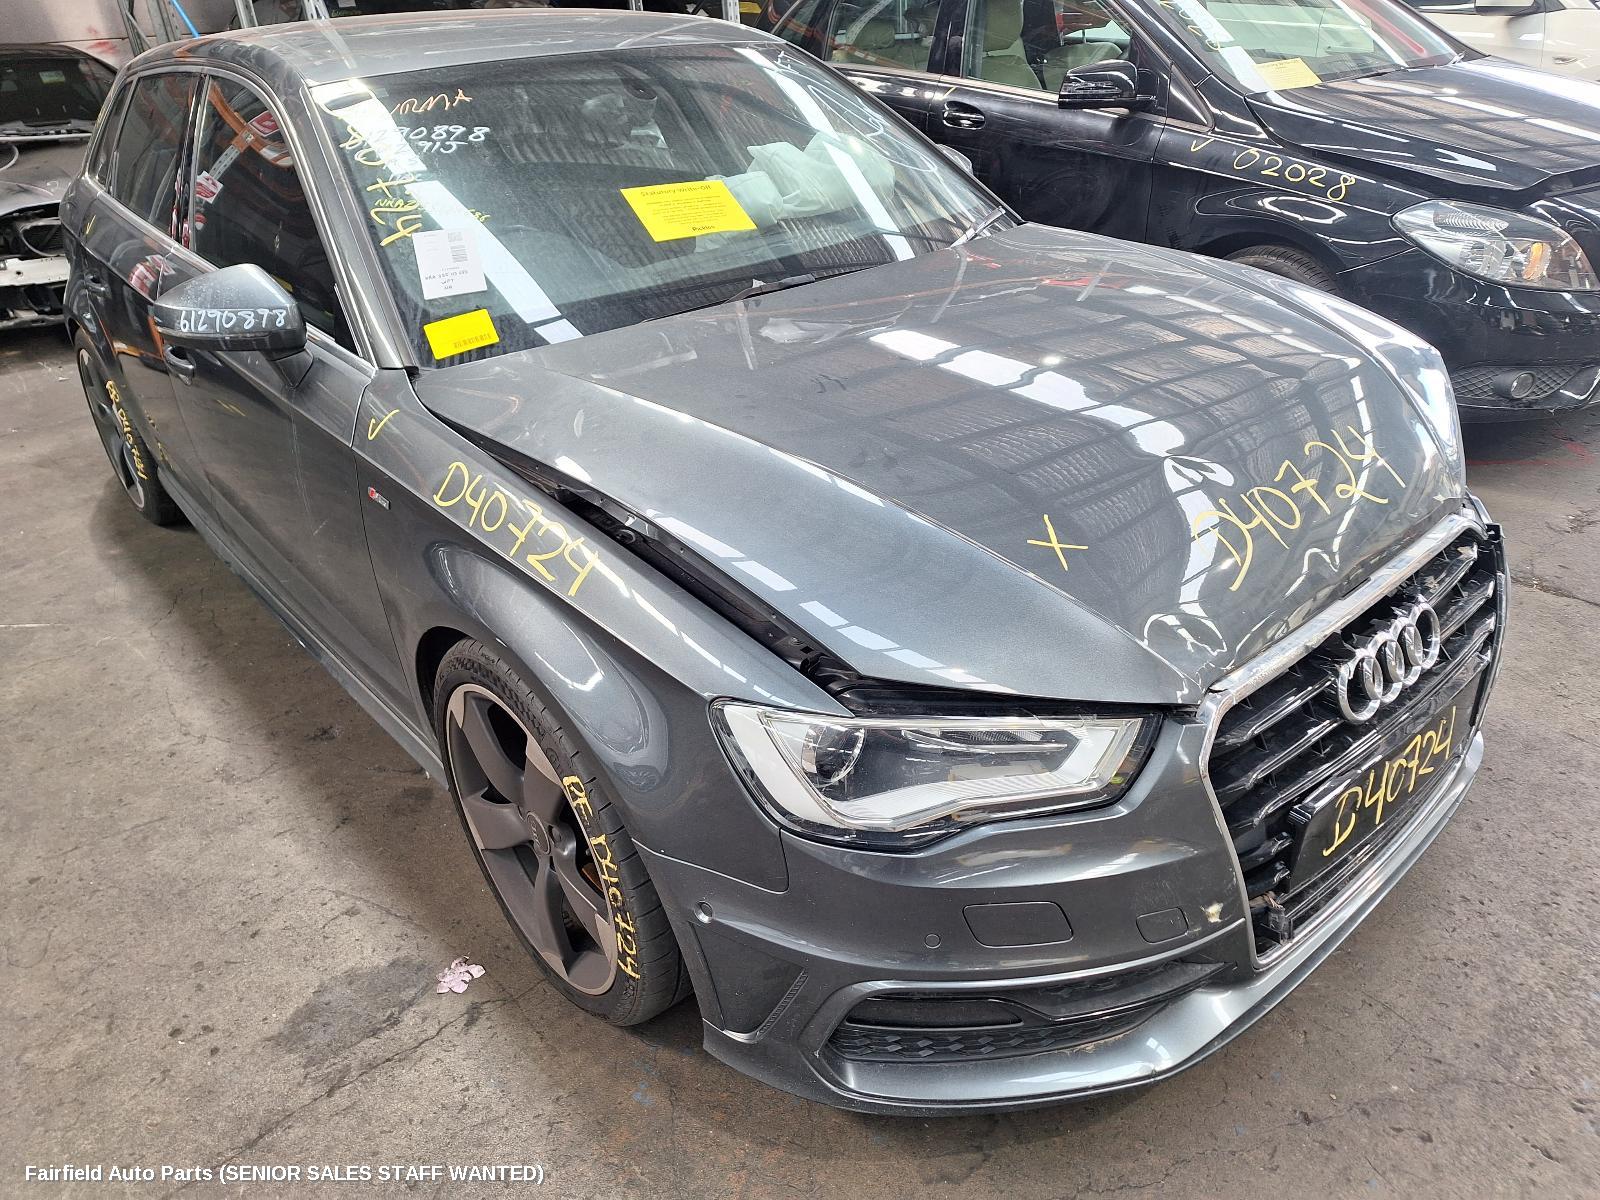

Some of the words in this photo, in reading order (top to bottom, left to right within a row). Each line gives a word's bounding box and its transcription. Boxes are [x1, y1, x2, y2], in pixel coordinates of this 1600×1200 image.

[1232, 147, 1356, 202] 02028
[433, 461, 600, 597] D40724
[1191, 425, 1407, 591] D40724
[1322, 705, 1457, 857] D40724
